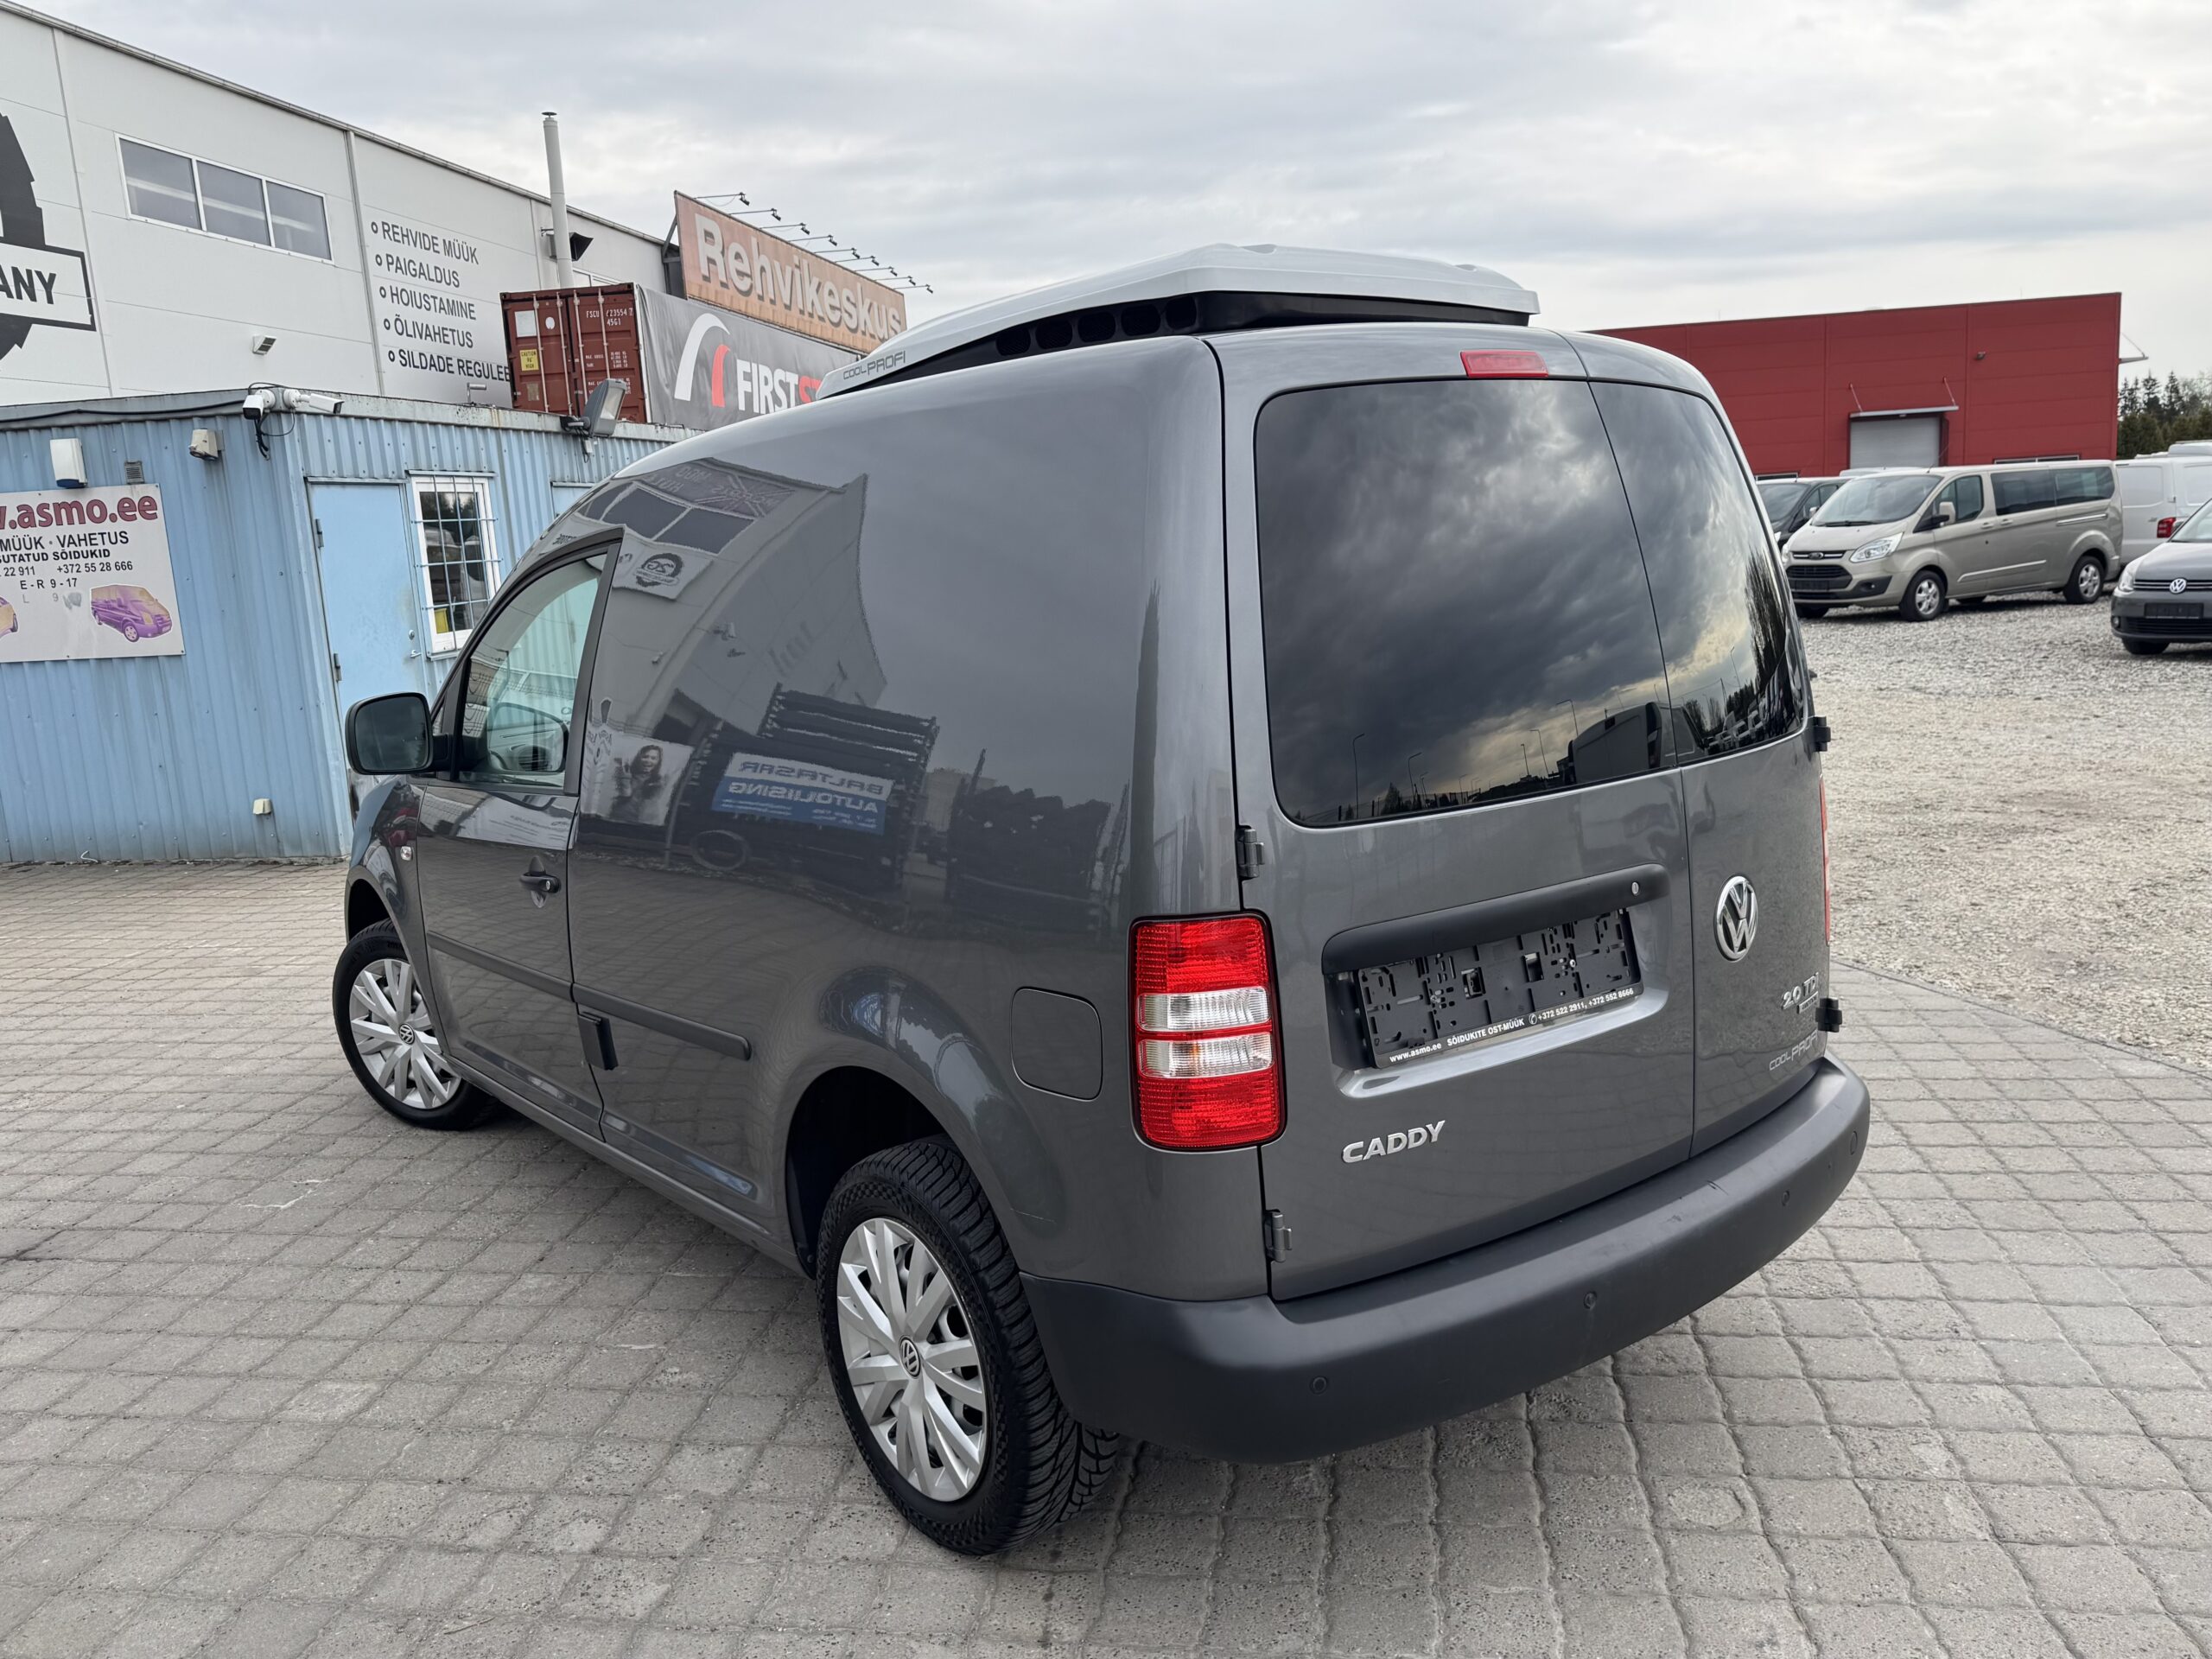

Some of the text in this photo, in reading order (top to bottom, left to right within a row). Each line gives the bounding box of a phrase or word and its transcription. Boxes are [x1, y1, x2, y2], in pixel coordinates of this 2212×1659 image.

[381, 220, 479, 264] REHVIDE MÜÜK
[385, 253, 460, 288] PAIGALDUS
[695, 213, 901, 342] Rehvikeskus
[390, 284, 477, 321] HOIUSTAMINE
[394, 314, 474, 348] ÕLIVAHETUS
[398, 348, 454, 374] SILDADE
[0, 531, 130, 552] MÜÜK VAHETUS
[53, 549, 111, 561] SÕIDUKID
[3, 561, 133, 577] 22 911 +372 55 28 666
[66, 577, 78, 588] 17
[1389, 1042, 1442, 1063] www.asmo.ee
[1446, 1028, 1487, 1046] SÕIDUKITE
[1487, 1018, 1525, 1035] OST-MÜÜK
[1538, 1009, 1555, 1021] +372
[1555, 1006, 1568, 1016] 522
[1588, 996, 1605, 1007] +372
[1605, 992, 1618, 1002] 552
[1618, 987, 1634, 999] 8666
[1341, 1119, 1446, 1164] CADDY
